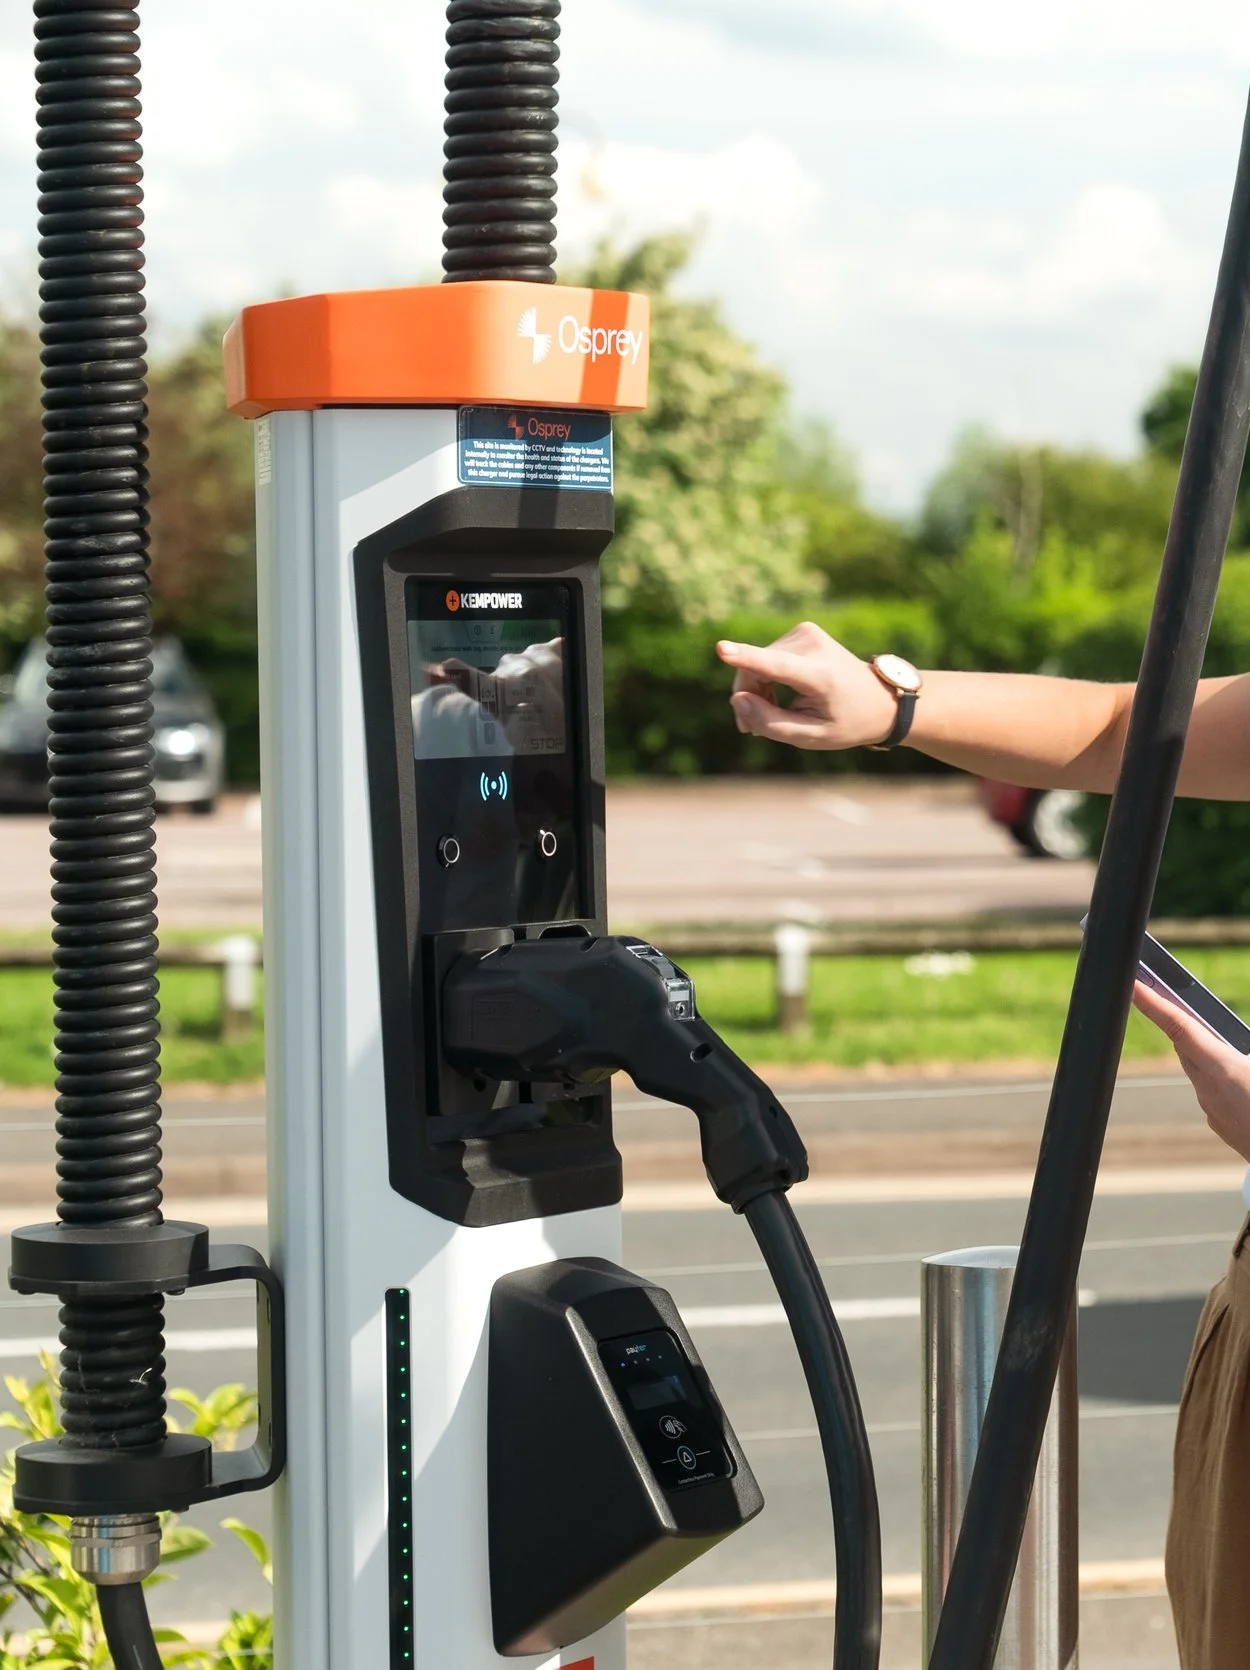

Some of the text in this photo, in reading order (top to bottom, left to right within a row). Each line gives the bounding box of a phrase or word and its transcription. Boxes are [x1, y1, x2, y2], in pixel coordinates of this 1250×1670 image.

[558, 315, 643, 365] Osprey
[528, 417, 572, 441] Osprey
[473, 441, 484, 449] This
[485, 441, 494, 449] site
[500, 443, 524, 451] monitored
[525, 444, 531, 452] by
[532, 444, 546, 452] CCTV
[556, 446, 582, 455] technology
[497, 452, 515, 460] monitor
[516, 452, 524, 460] the
[525, 453, 540, 461] health
[464, 459, 475, 467] will
[498, 461, 514, 469] cables
[468, 468, 478, 476] this
[479, 469, 498, 478] charger
[526, 472, 538, 480] legal
[554, 473, 571, 481] against
[461, 593, 523, 609] KEMPOWER
[531, 737, 564, 750] STOP
